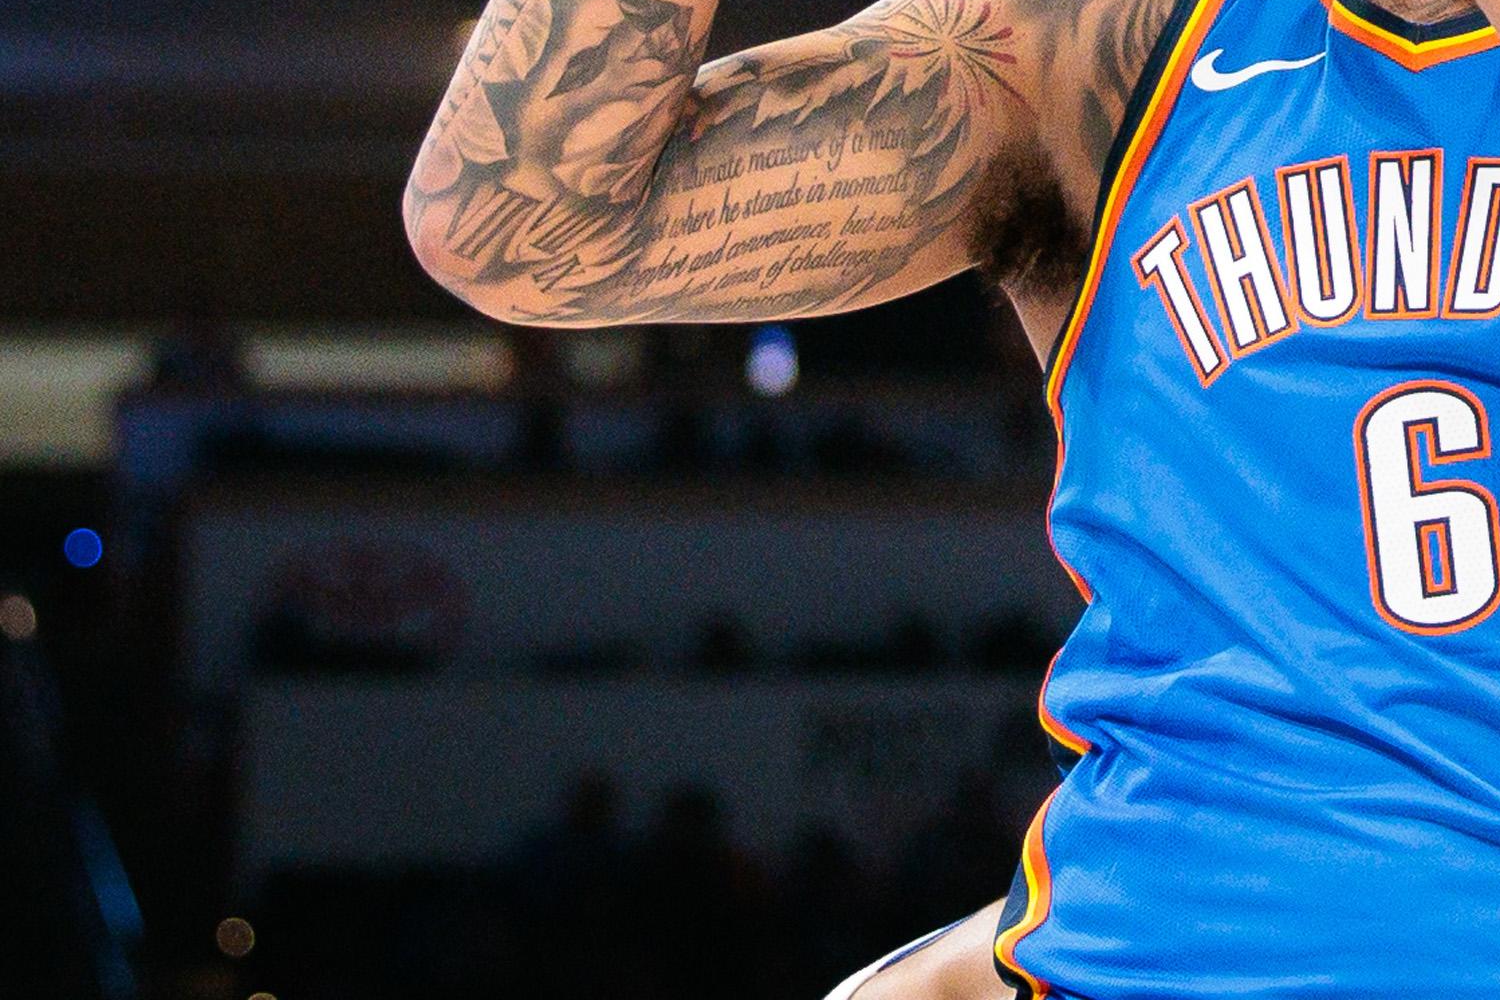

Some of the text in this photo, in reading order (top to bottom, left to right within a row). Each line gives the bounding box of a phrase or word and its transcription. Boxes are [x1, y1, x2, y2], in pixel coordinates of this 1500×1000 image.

[718, 186, 741, 226] he
[742, 170, 803, 220] stands
[806, 175, 827, 204] in
